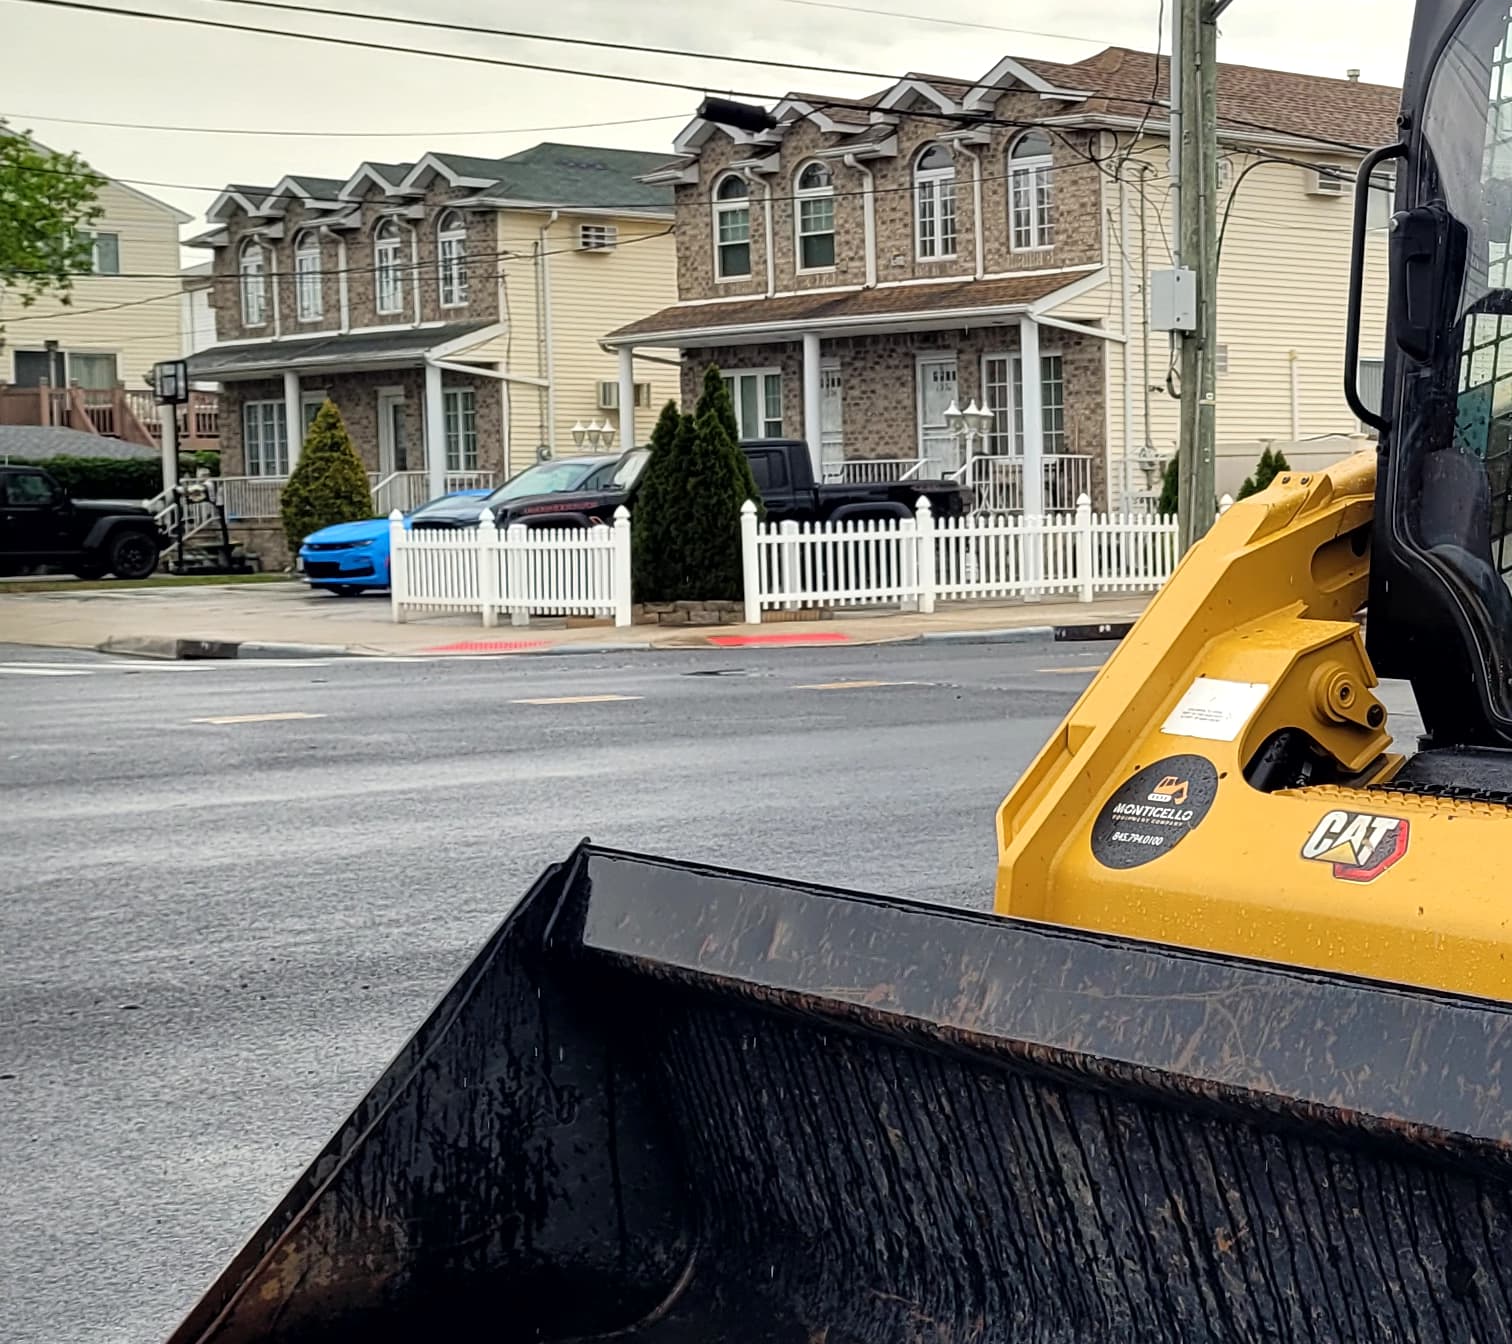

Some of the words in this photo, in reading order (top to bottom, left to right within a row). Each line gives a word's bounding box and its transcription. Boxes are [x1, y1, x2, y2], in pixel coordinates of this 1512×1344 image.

[1111, 814, 1151, 824] EQUIPMENT
[1151, 818, 1184, 827] COMPANY
[1112, 802, 1194, 821] MONTICELLO
[1302, 811, 1401, 866] CAT
